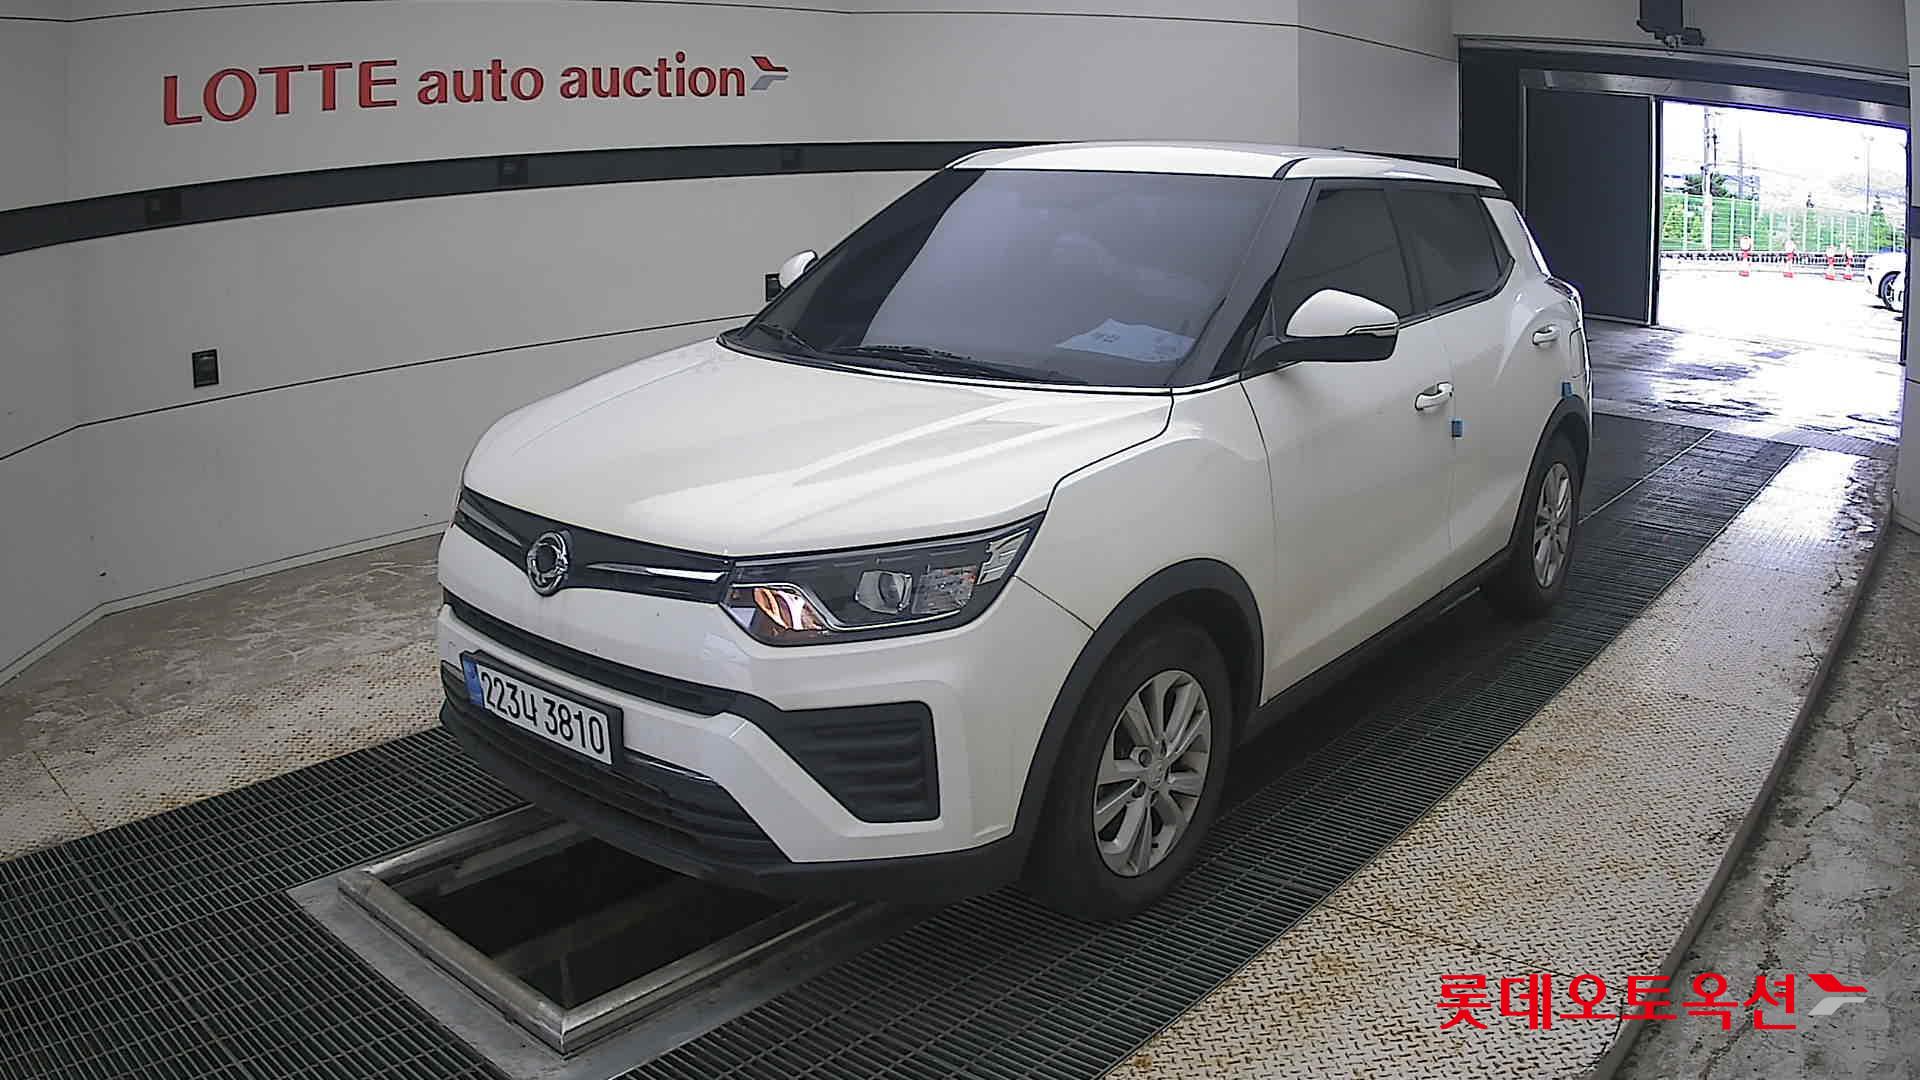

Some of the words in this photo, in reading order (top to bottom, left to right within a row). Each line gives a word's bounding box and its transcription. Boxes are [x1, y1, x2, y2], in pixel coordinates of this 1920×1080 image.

[163, 60, 399, 126] LOTTE
[416, 59, 545, 105] auto
[560, 51, 746, 98] auction
[481, 672, 538, 727] 223나
[543, 697, 605, 755] 3810
